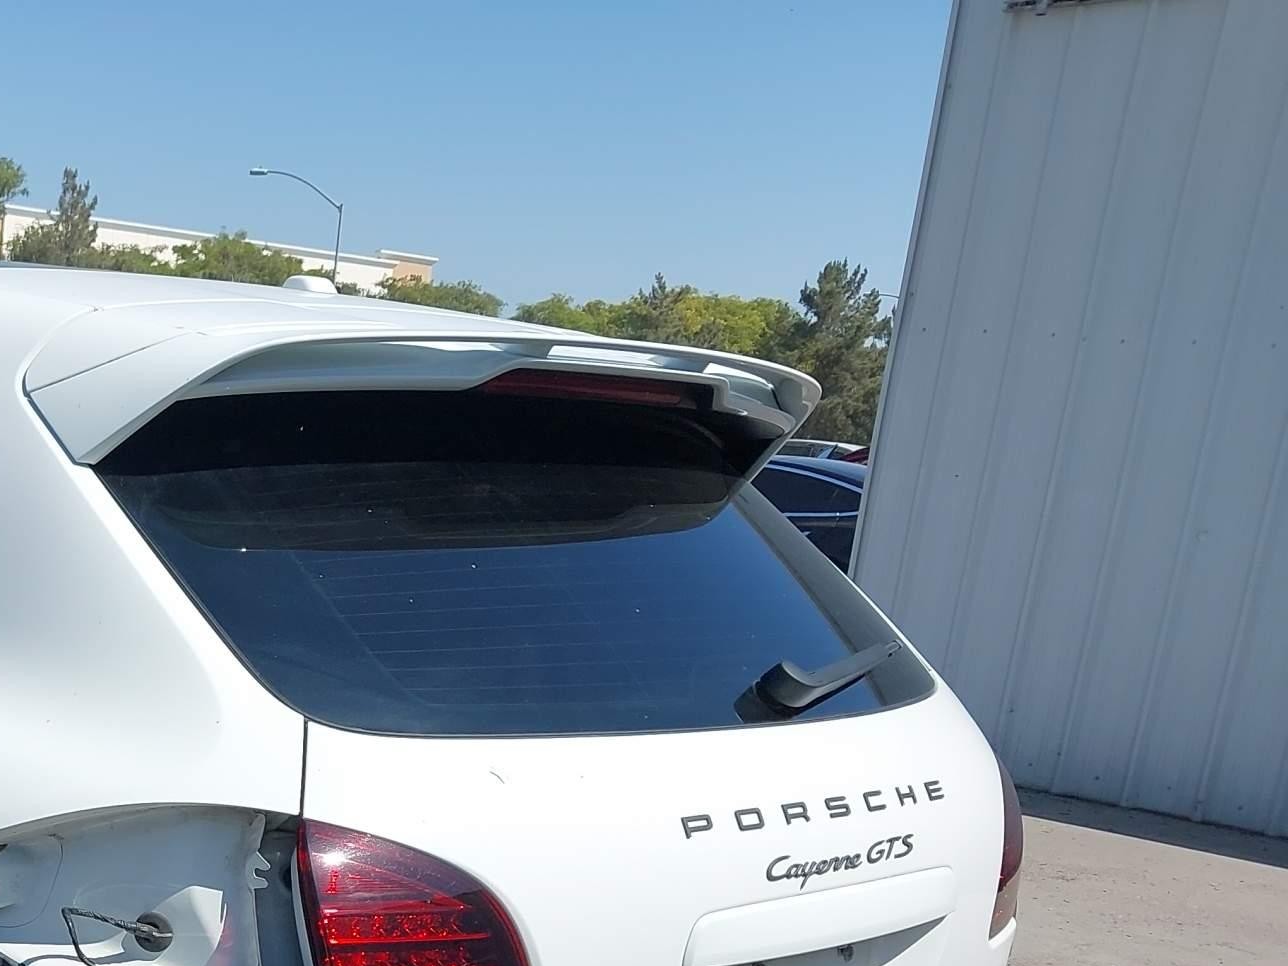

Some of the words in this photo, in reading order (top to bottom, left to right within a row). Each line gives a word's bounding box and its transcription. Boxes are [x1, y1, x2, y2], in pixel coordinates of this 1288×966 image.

[680, 779, 946, 840] PORSCHE
[765, 853, 864, 891] Cayenne
[865, 833, 915, 864] GTS
